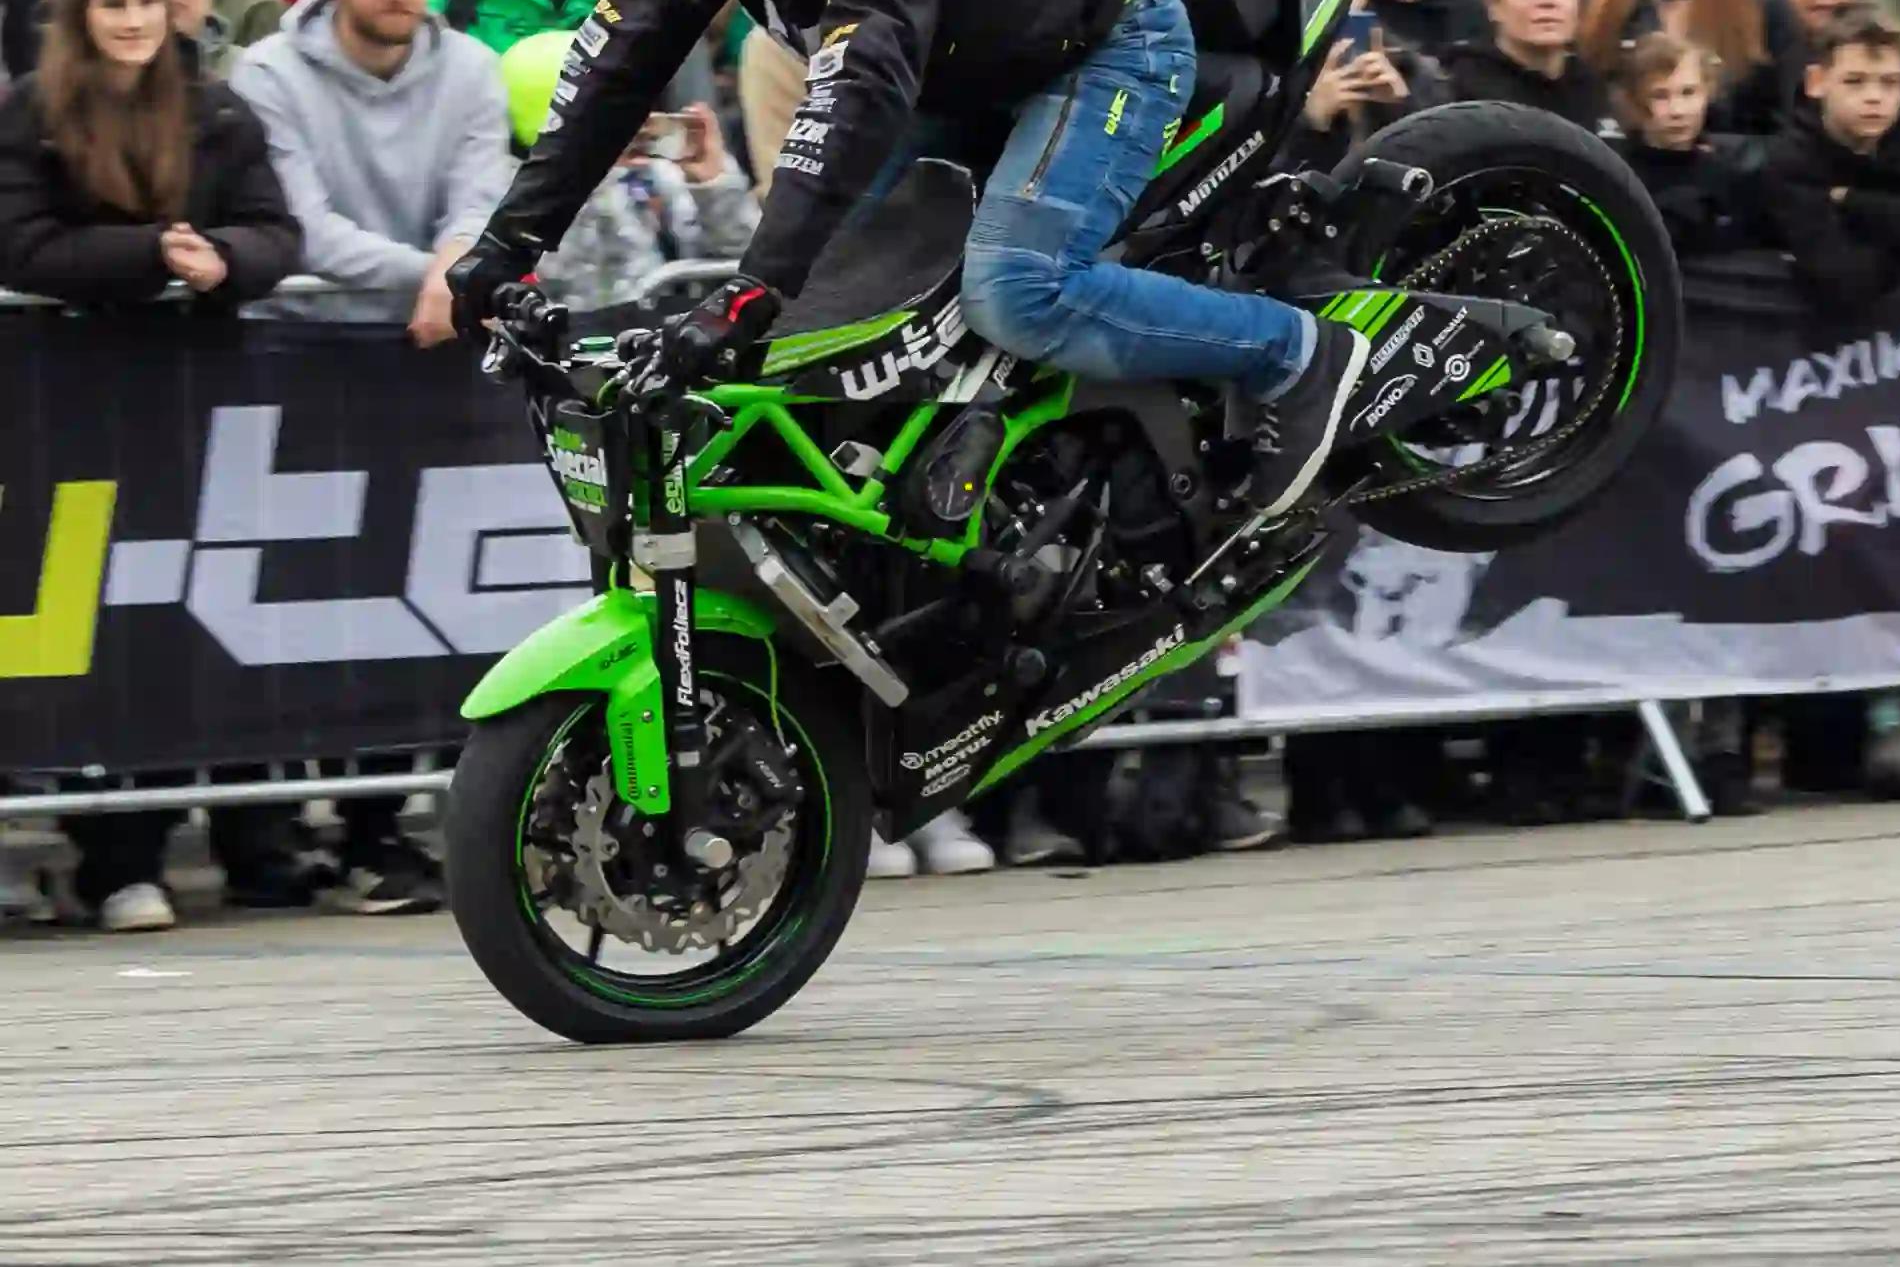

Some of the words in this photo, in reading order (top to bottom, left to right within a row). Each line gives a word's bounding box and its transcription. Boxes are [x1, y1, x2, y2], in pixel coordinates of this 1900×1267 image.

[1365, 387, 1403, 429] BONO
[1025, 623, 1185, 738] Kawasaki
[925, 735, 993, 781] MOTUL
